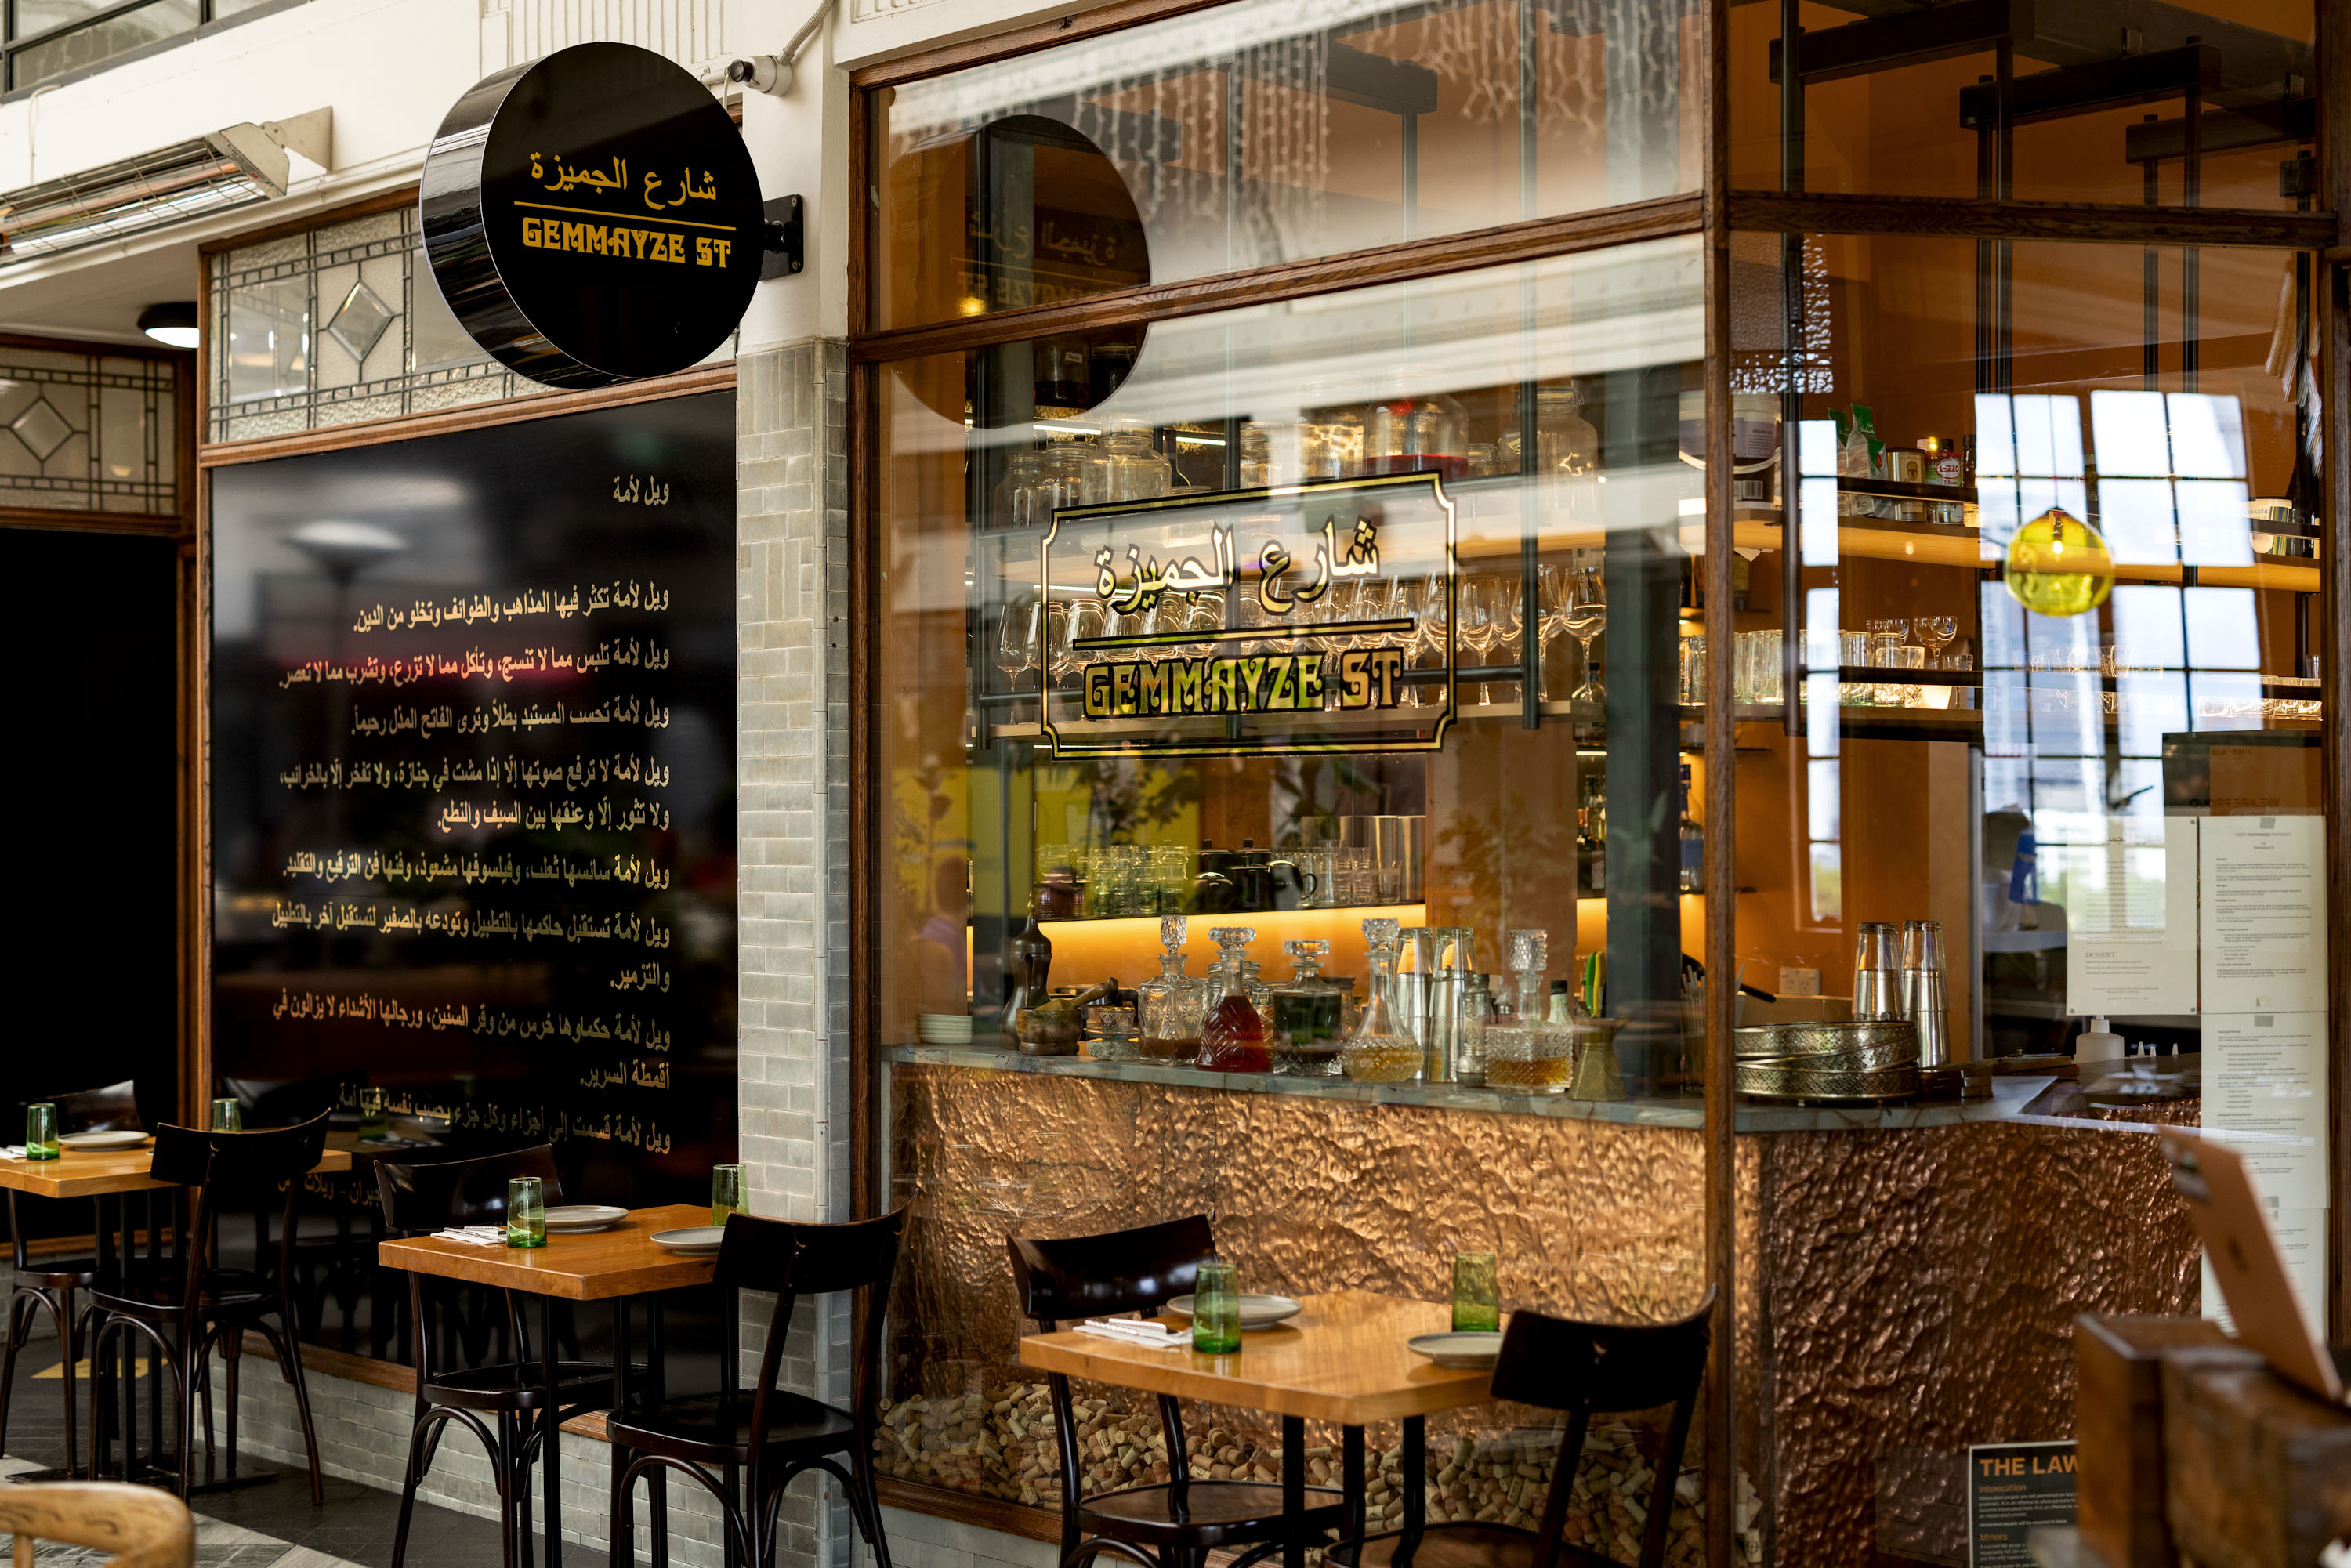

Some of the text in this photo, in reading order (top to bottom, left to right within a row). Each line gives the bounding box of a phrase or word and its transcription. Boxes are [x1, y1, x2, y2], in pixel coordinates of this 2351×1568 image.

[528, 150, 717, 210] شارع الجميزة
[521, 216, 732, 269] GEMMAYZE ST
[612, 473, 669, 506] ويل لأمة
[1093, 514, 1380, 615] شارع الجميزة
[502, 588, 549, 621] المذاهب
[553, 584, 579, 620] فيها
[581, 583, 610, 617] تكثر
[612, 578, 640, 609] لأمة
[643, 580, 669, 612] ويل
[353, 603, 384, 633] الدين.
[386, 607, 404, 631] من
[406, 599, 440, 629] وتخلو
[425, 653, 435, 677] لا
[437, 653, 458, 675] مما
[459, 645, 494, 679] وتأكل
[496, 647, 534, 683] تنسج،
[537, 646, 548, 672] لا
[550, 646, 573, 668] مما
[575, 642, 610, 674] تلبس
[612, 636, 640, 667] لأمة
[643, 638, 669, 671] ويل
[312, 659, 323, 683] لا
[324, 658, 343, 680] مما
[345, 654, 386, 685] وتشرب
[389, 654, 423, 687] تزرع،
[1082, 646, 1404, 720] GEMMAYZE ST
[388, 704, 417, 735] المذل
[420, 704, 452, 740] الفاتح
[456, 705, 489, 733] وترى
[491, 697, 517, 732] بطلاً
[520, 701, 565, 732] المستبد
[568, 700, 610, 724] تحسب
[612, 693, 640, 724] لأمة
[643, 697, 669, 729] ويل
[344, 760, 371, 789] تفخر
[373, 761, 391, 789] ولا
[432, 756, 449, 793] في
[451, 758, 483, 781] مشت
[520, 759, 563, 789] صوتها
[566, 753, 596, 792] ترفع
[598, 757, 610, 783] لا
[613, 751, 640, 783] لأمة
[643, 755, 669, 788] ويل
[437, 798, 480, 834] والنطع.
[482, 799, 521, 830] السيف
[524, 805, 546, 830] بين
[615, 797, 646, 831] تثور
[648, 800, 670, 831] ولا
[325, 849, 361, 883] الترقيع
[364, 849, 379, 881] فن
[381, 849, 411, 882] وفنها
[460, 851, 520, 885] وفيلسوفها
[613, 853, 641, 884] لأمة
[644, 857, 670, 890] ويل
[271, 900, 670, 949] ويل لأمة تستقبل حاكمها بالتطبيل وتودعه بالصفير لتستقبل آخر بالتطبيل
[609, 960, 670, 993] والتزمير.
[272, 986, 288, 1020] في
[325, 994, 335, 1016] لا
[379, 998, 423, 1029] ورجالها
[426, 1003, 469, 1030] السنين،
[497, 1011, 516, 1037] من
[519, 1011, 555, 1041] خرس
[613, 1012, 641, 1045] لأمة
[644, 1019, 671, 1052] ويل
[579, 1057, 670, 1090] أقمطة السرير.
[359, 1085, 381, 1117] فيها
[482, 1101, 506, 1133] وكل
[571, 1113, 611, 1140] قسمت
[614, 1113, 642, 1146] لأمة
[645, 1121, 671, 1155] ويل
[1979, 1458, 2026, 1477] THE
[1979, 1483, 2027, 1492] Intoxication
